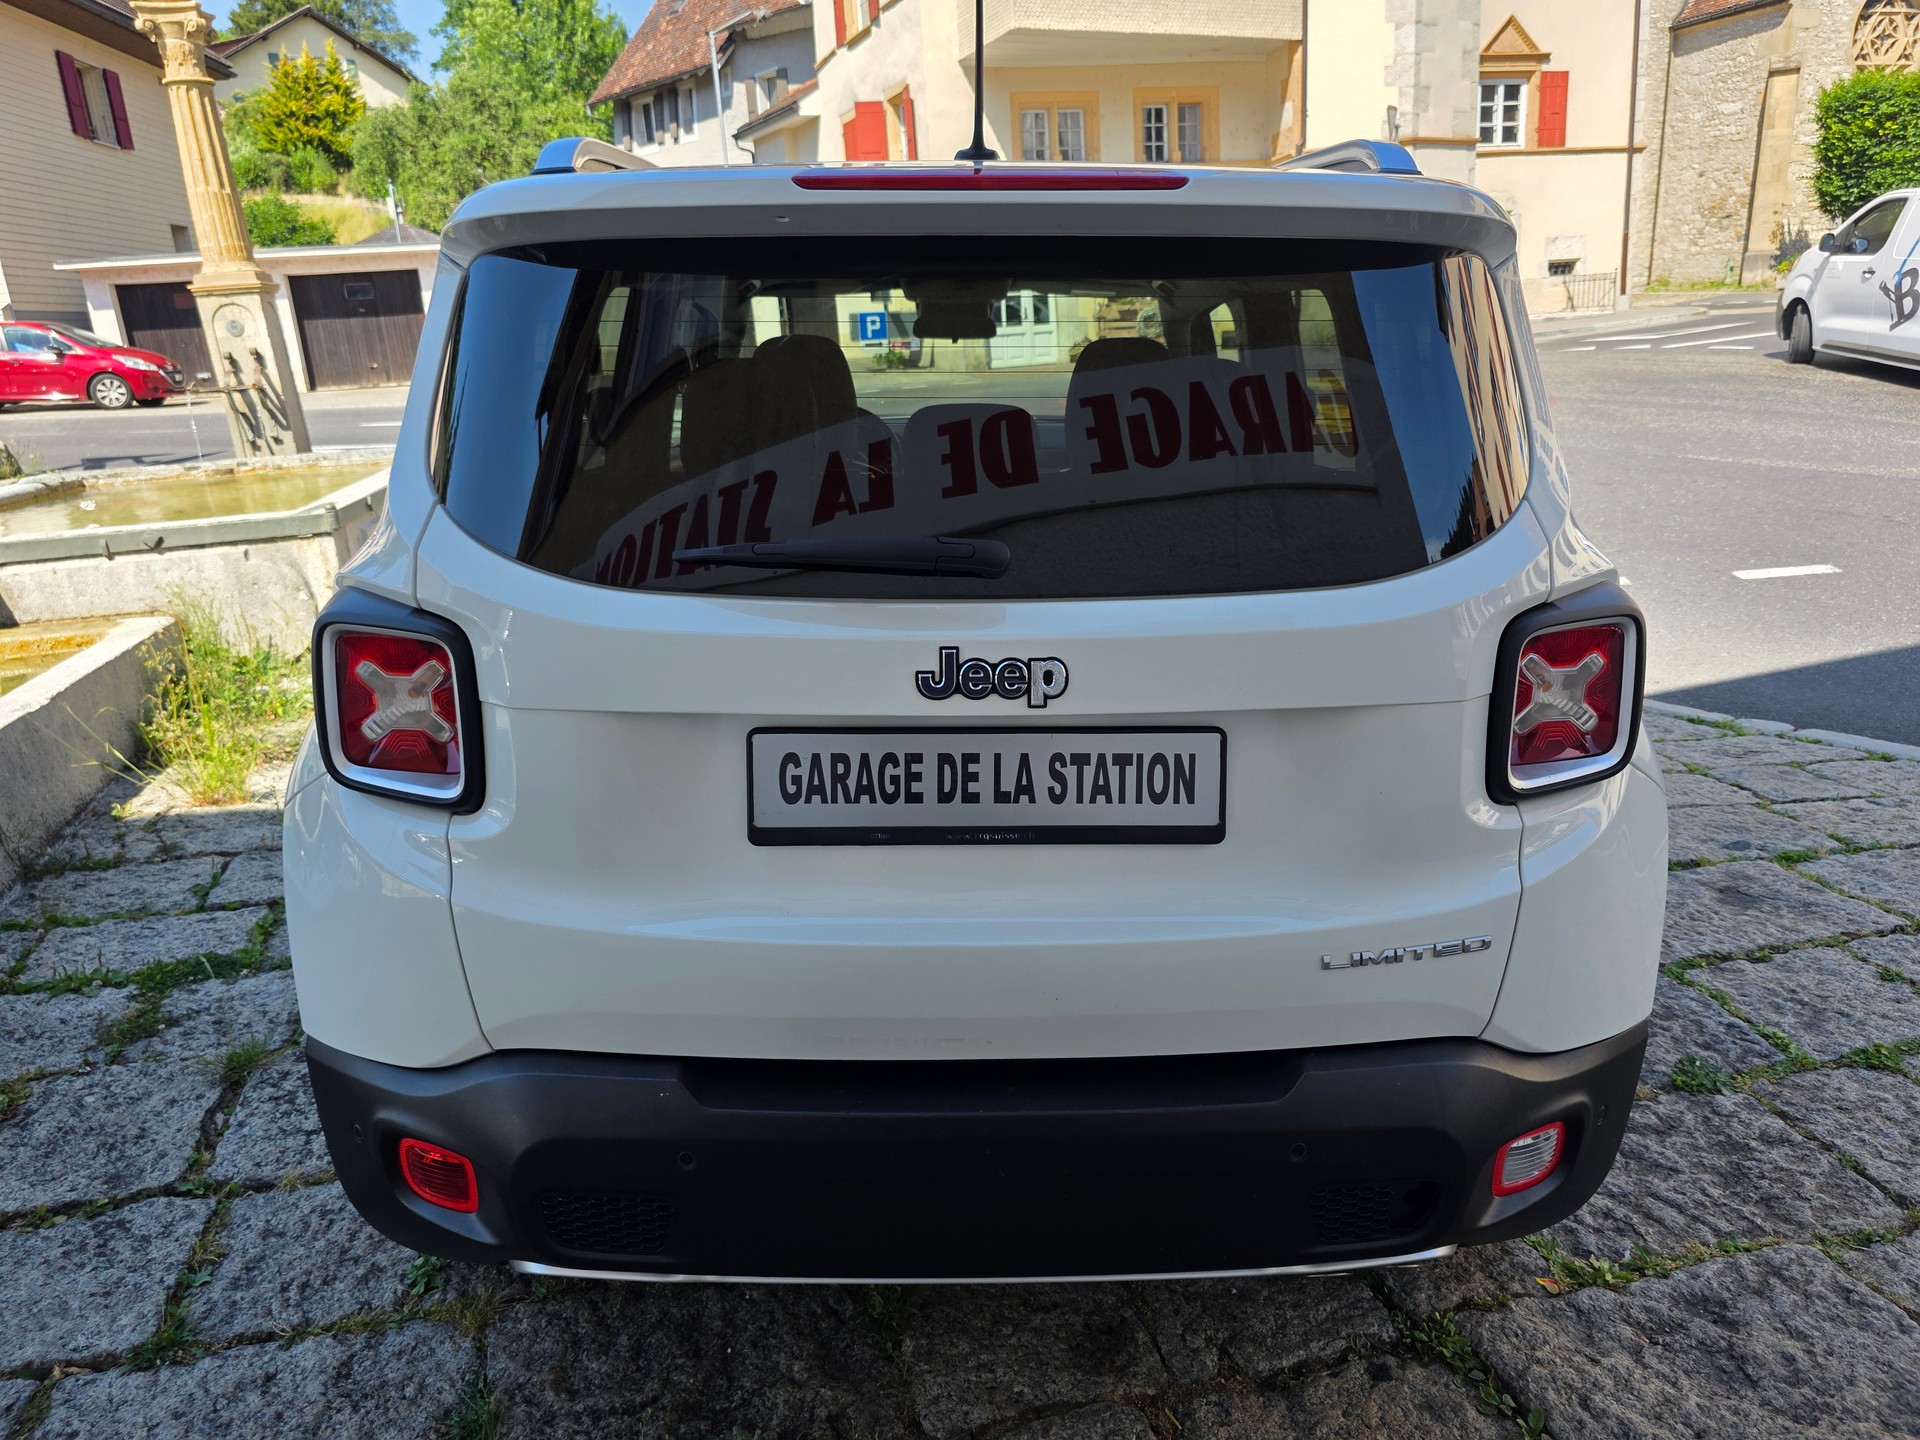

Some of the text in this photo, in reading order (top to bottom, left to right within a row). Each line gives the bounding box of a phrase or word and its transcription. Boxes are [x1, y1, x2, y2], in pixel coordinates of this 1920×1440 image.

[866, 315, 881, 338] P
[915, 645, 1070, 709] Jeep
[778, 751, 1197, 806] GARAGE DE LA STATION
[1321, 934, 1492, 971] LIMITED
